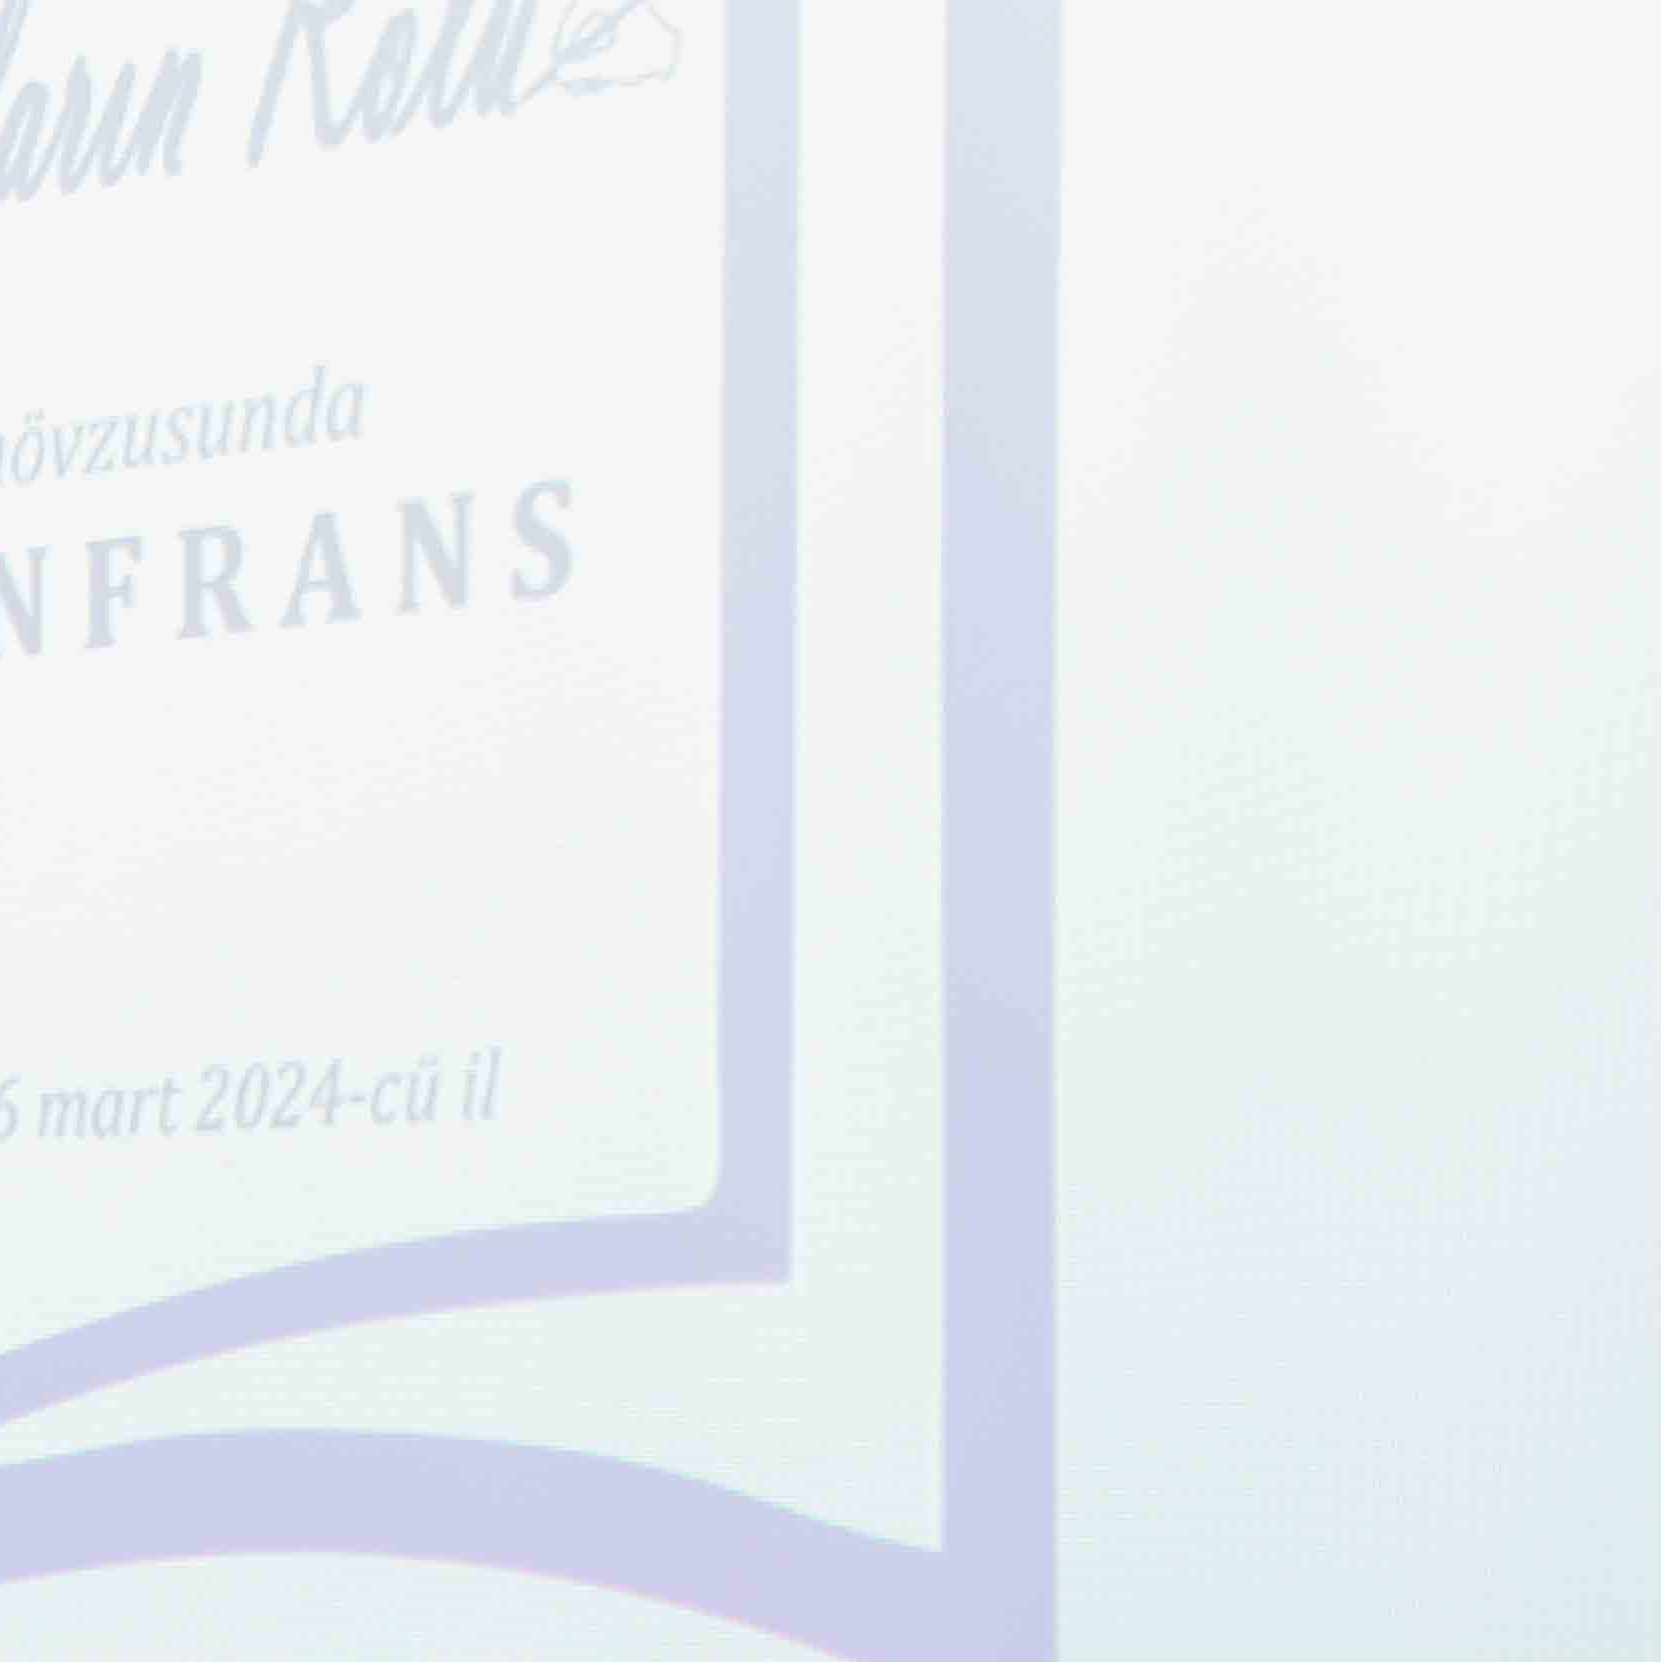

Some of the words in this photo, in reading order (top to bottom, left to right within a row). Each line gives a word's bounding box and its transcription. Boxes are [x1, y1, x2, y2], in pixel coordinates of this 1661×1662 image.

[37, 1080, 182, 1138] mart
[193, 1050, 441, 1133] 2024-cü
[461, 1045, 503, 1121] il
